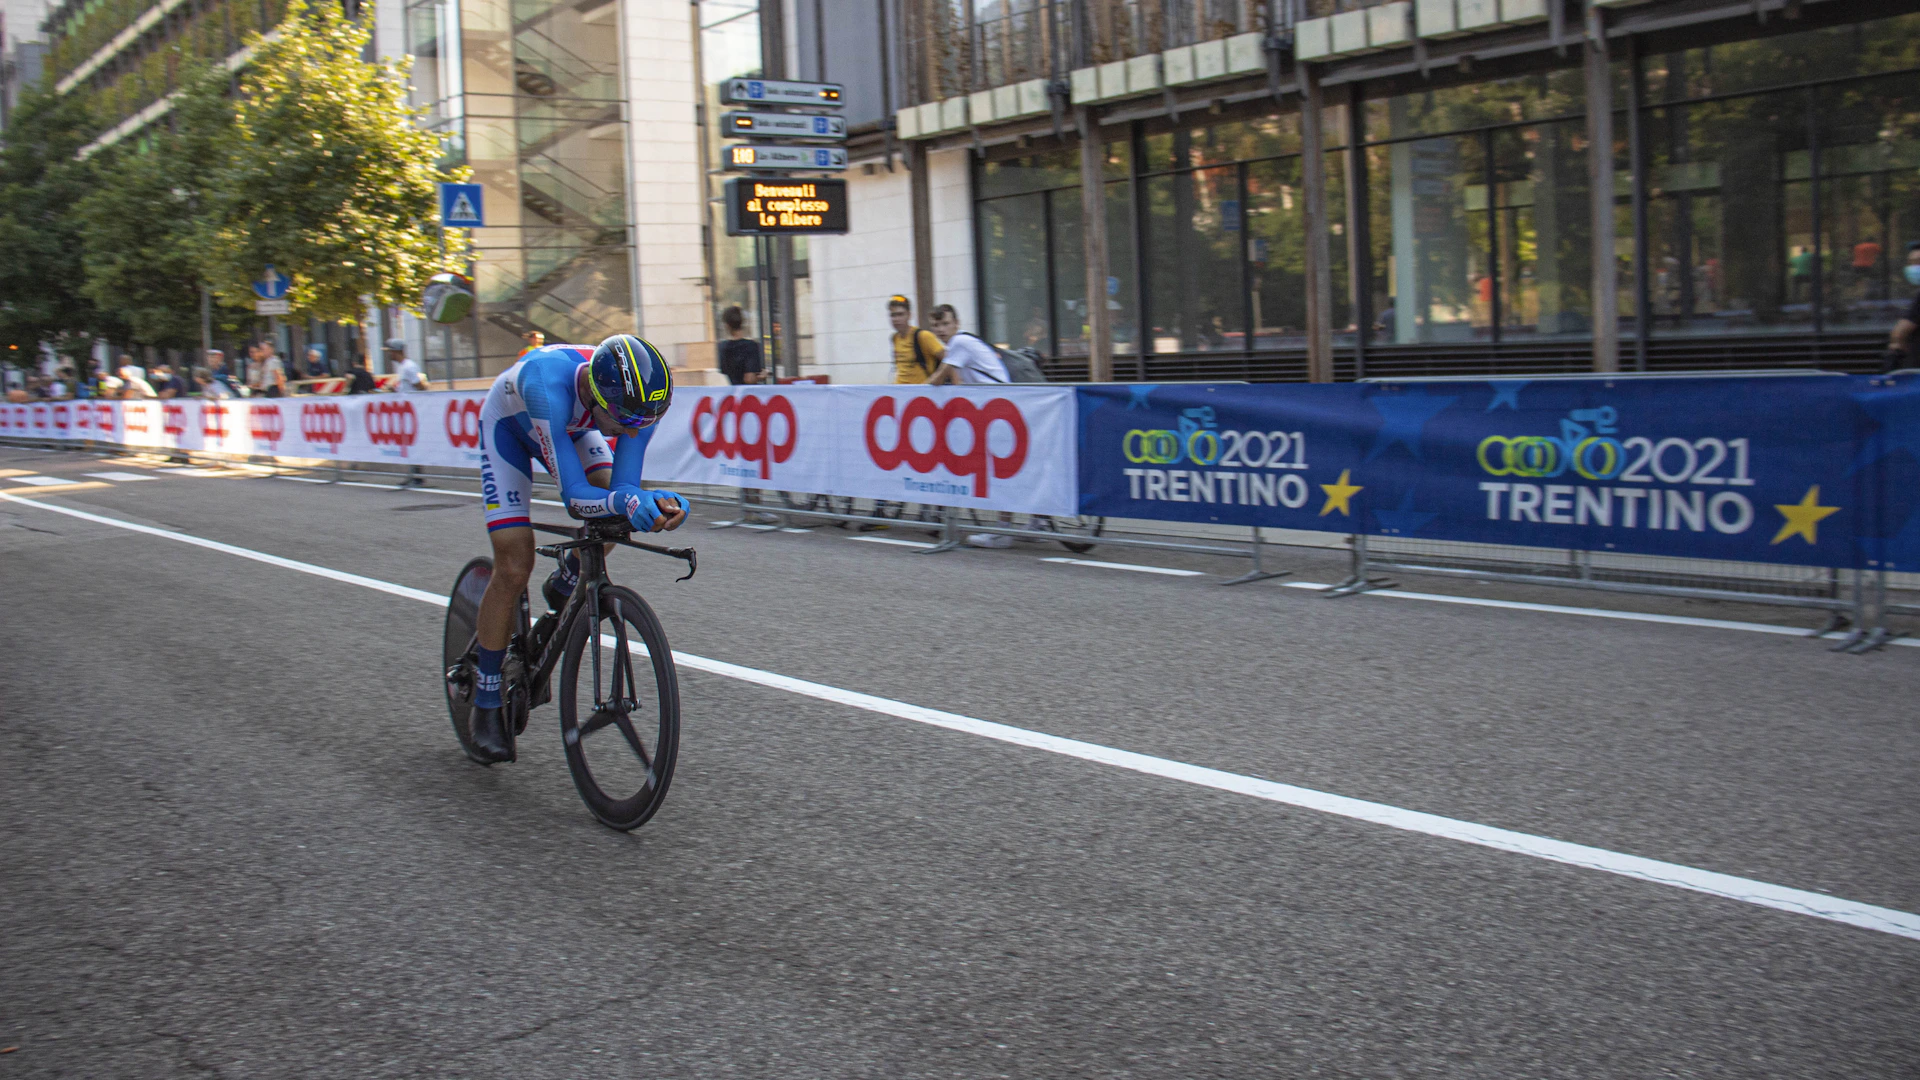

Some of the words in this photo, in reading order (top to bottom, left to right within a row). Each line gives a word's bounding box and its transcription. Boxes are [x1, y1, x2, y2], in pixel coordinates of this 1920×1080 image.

[747, 199, 762, 212] al
[767, 199, 829, 213] complesso
[865, 395, 1030, 498] coop
[1218, 430, 1309, 469] 2021
[1618, 436, 1755, 486] 2021
[903, 476, 969, 496] Trentino
[1123, 468, 1309, 509] TRENTINO
[1478, 481, 1755, 534] TRENTINO
